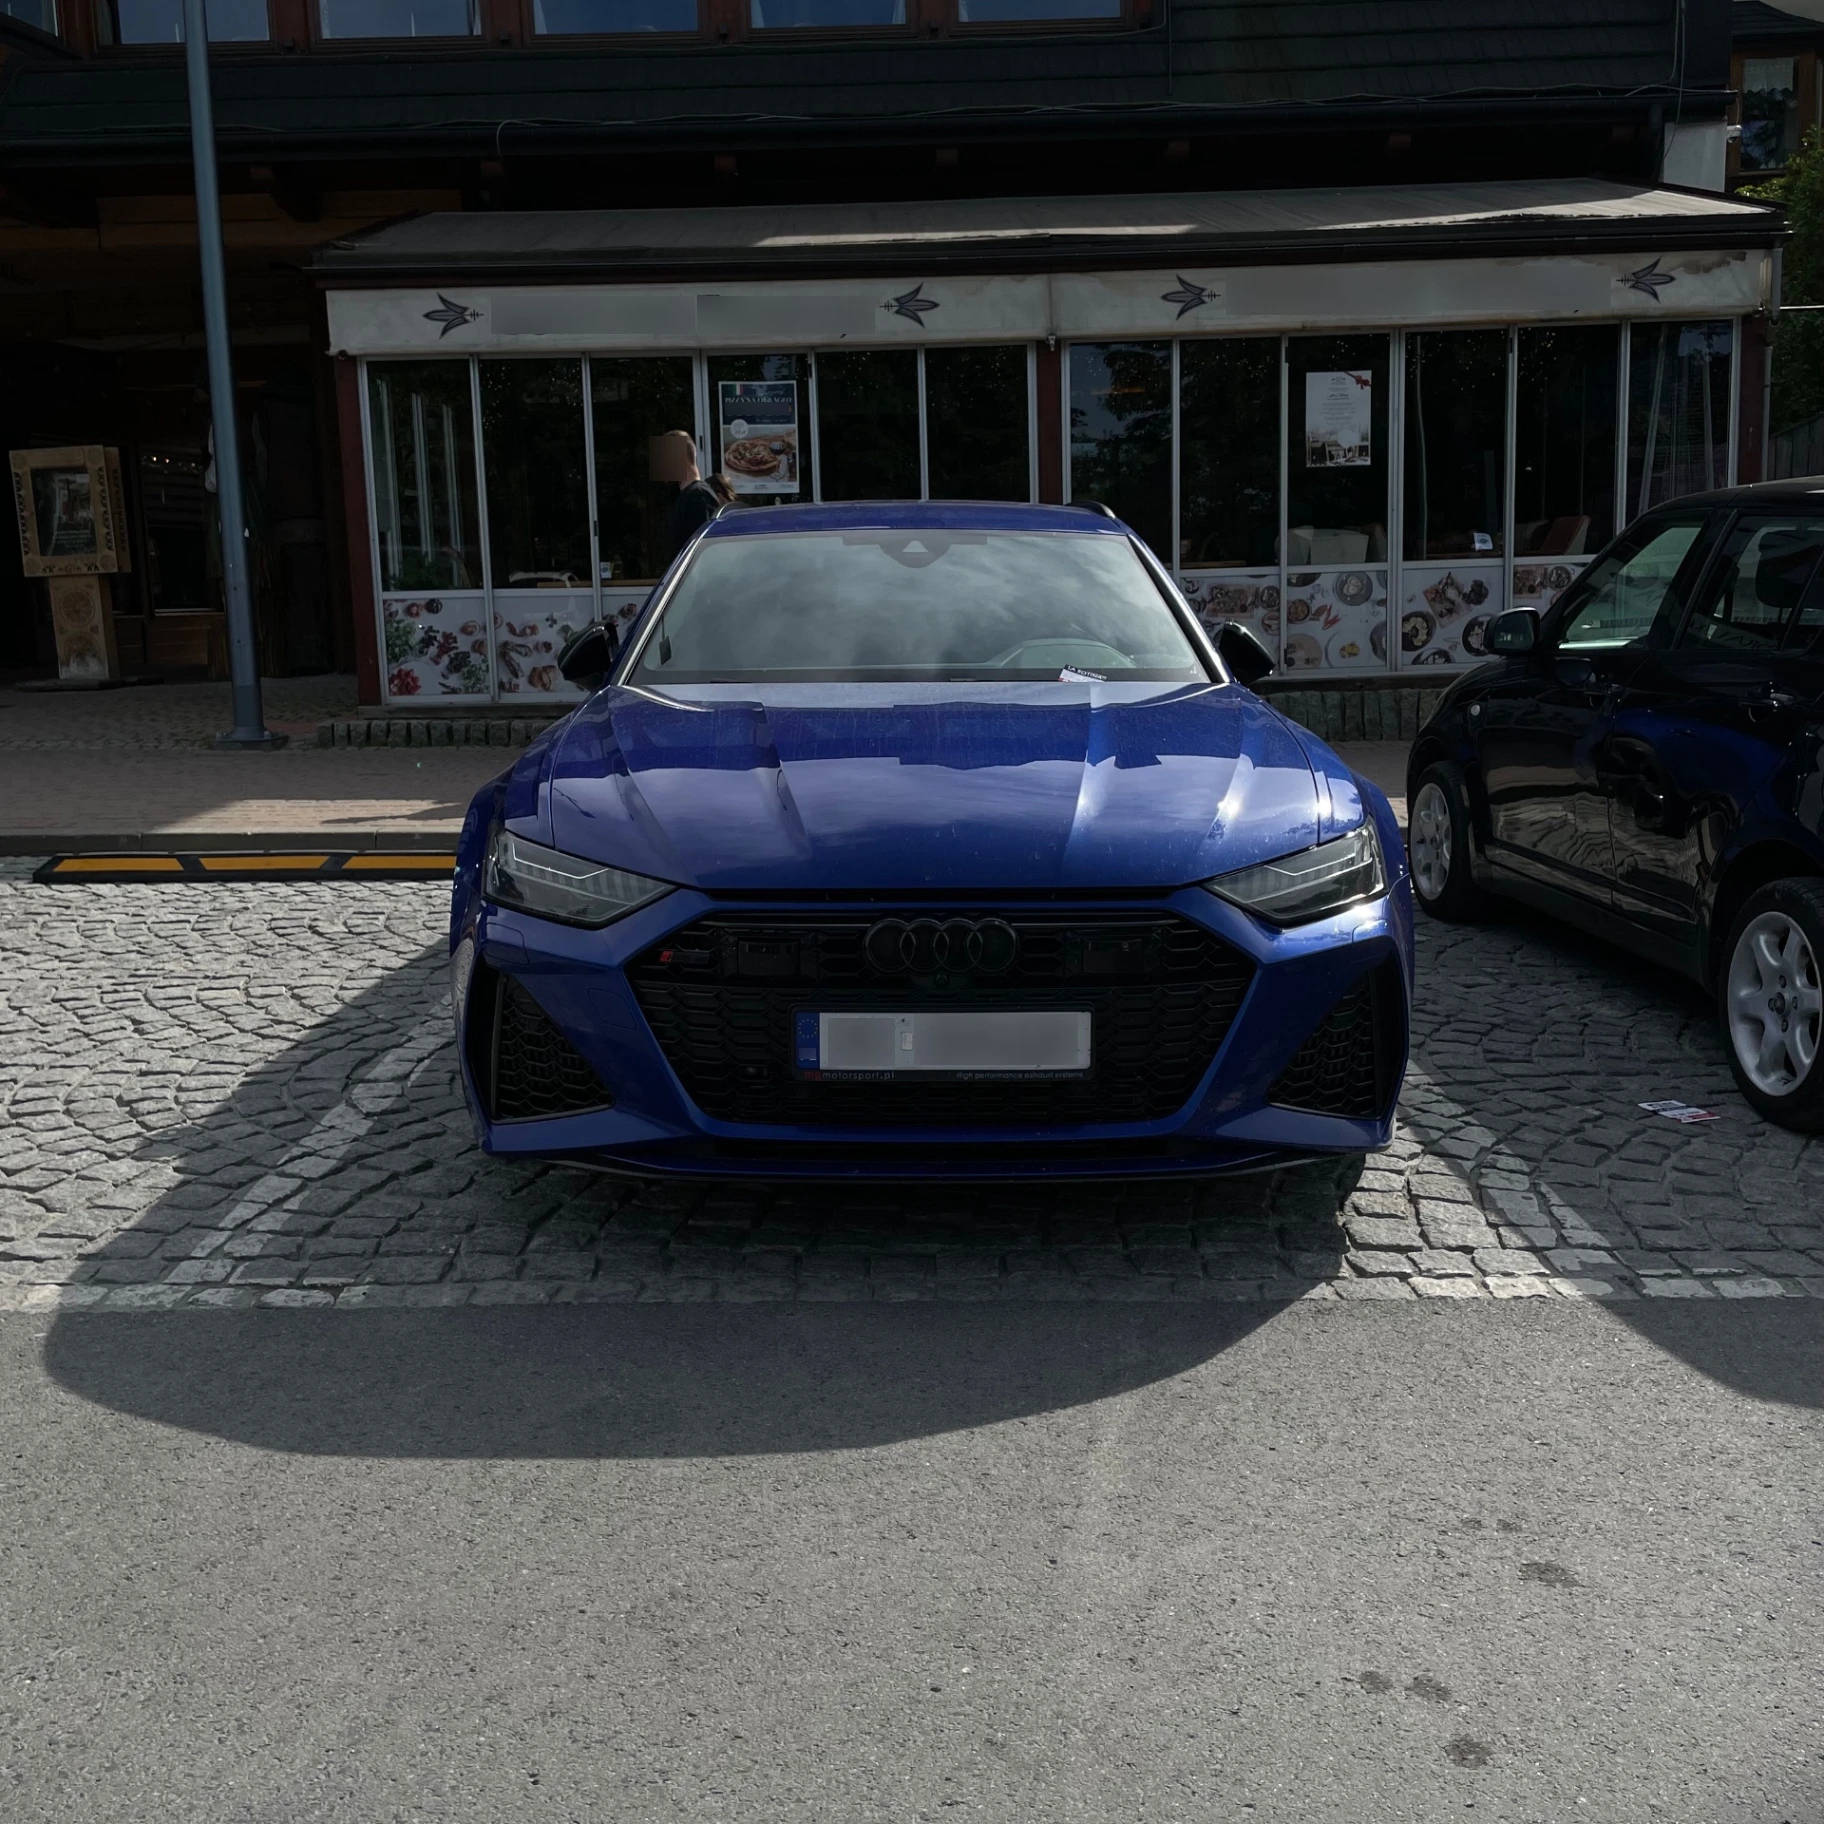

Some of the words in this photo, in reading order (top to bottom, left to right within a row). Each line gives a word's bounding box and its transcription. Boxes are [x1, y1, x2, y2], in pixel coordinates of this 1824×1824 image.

[956, 1071, 974, 1080] High
[975, 1071, 1022, 1080] performance
[1024, 1071, 1053, 1079] exhaust
[1054, 1071, 1084, 1079] systems
